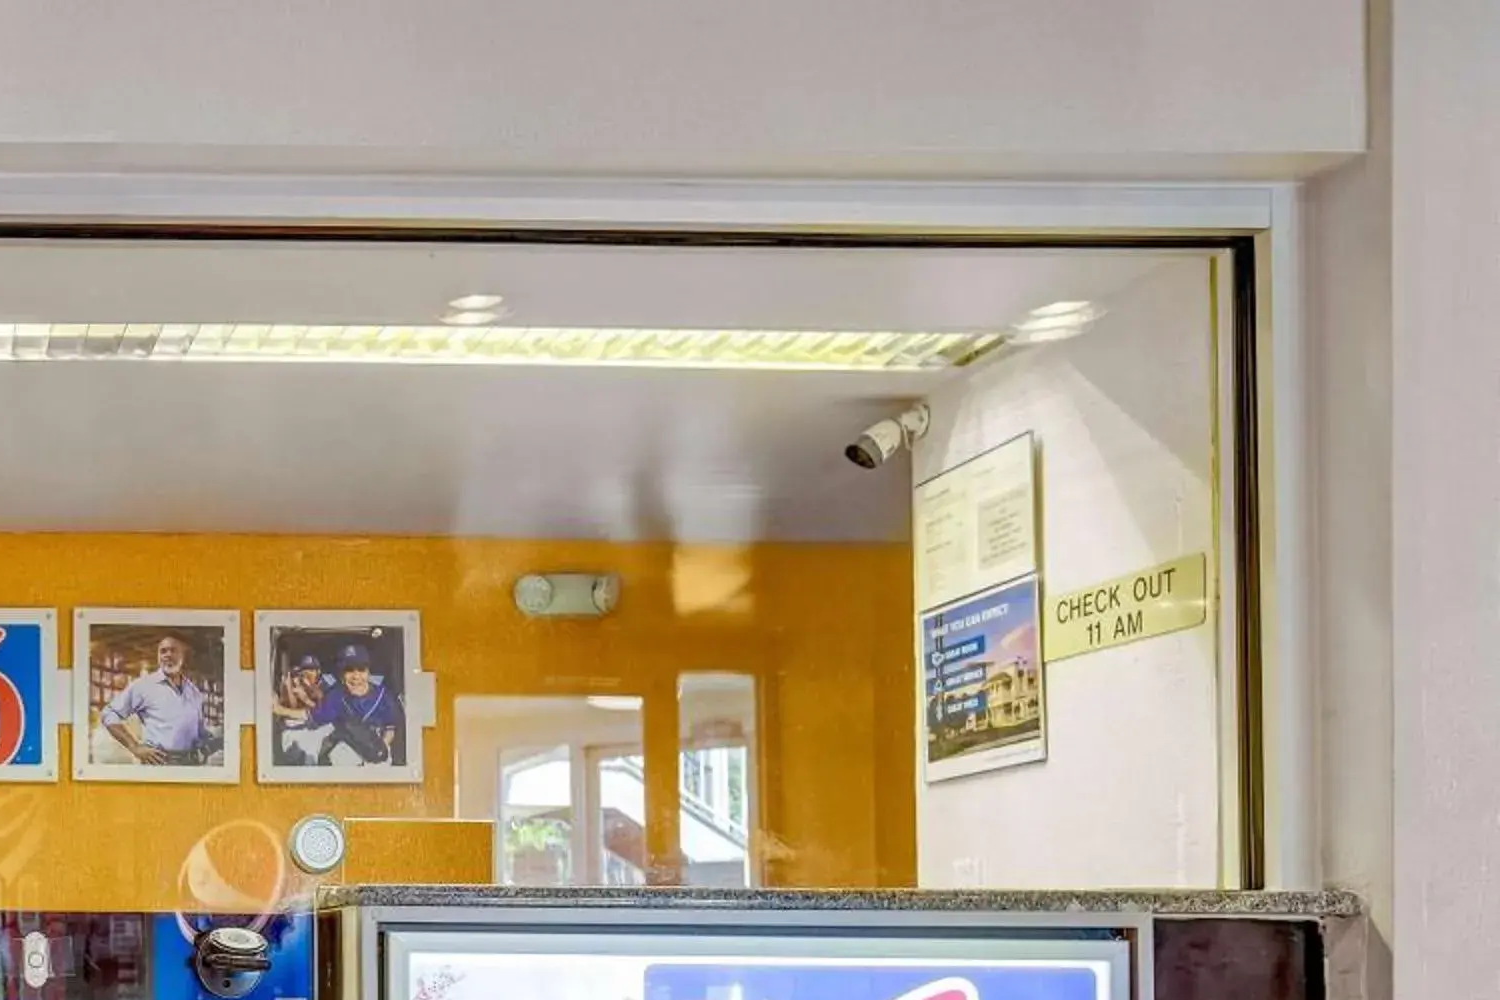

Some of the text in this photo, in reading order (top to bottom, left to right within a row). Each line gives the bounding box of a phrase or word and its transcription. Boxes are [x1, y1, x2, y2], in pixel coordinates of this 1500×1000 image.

[1056, 568, 1176, 624] CHECK OUT
[1086, 610, 1143, 645] 11 AM
